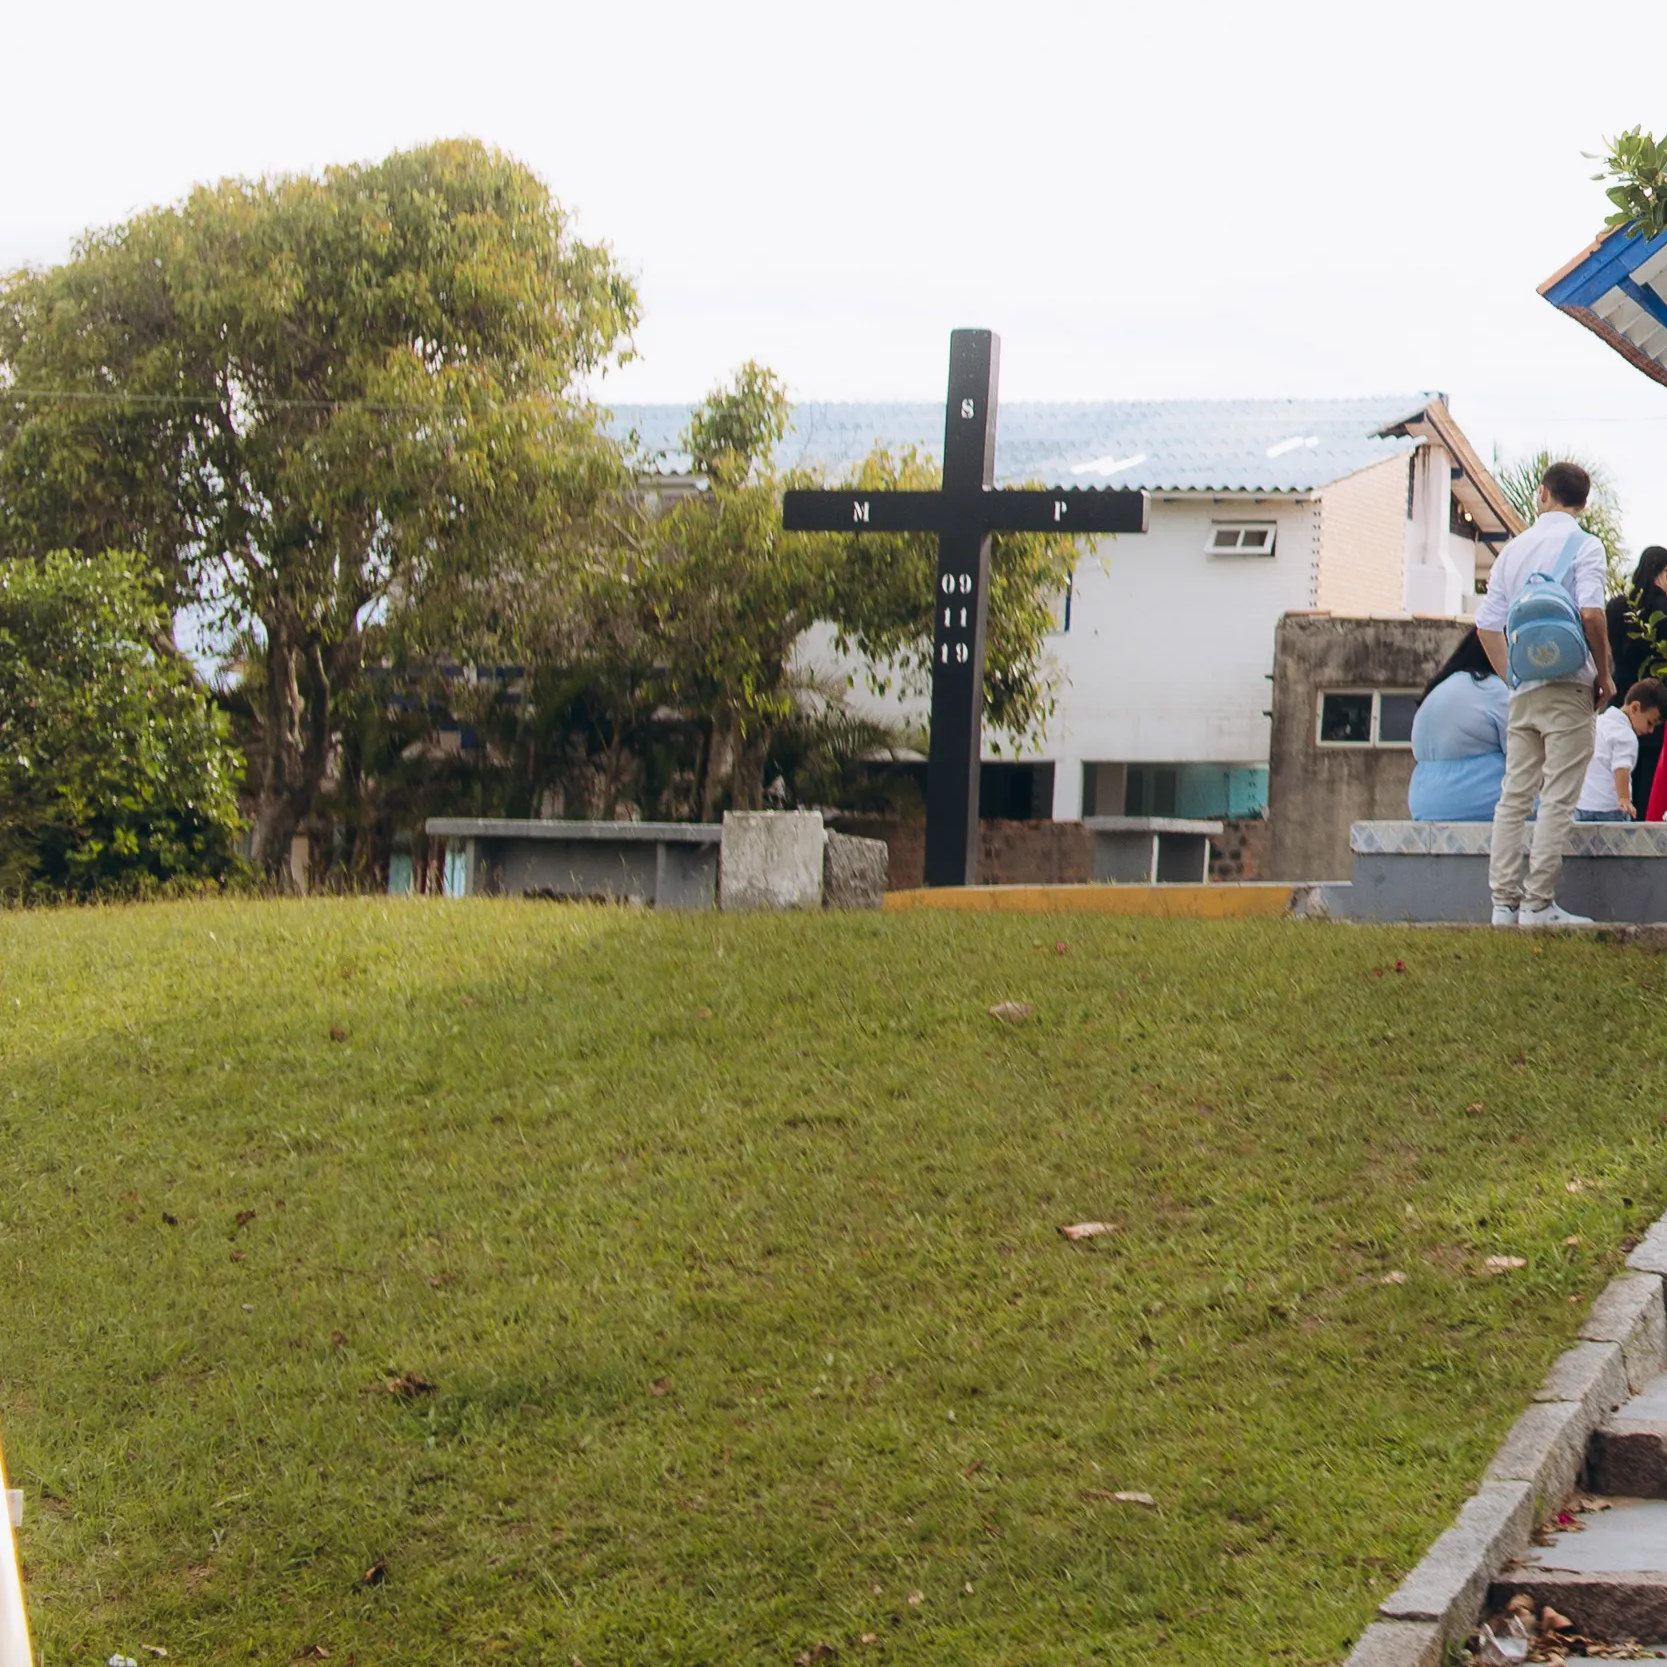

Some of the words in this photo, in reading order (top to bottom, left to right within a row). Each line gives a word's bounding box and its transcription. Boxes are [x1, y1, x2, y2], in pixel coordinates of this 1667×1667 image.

[960, 398, 974, 419] S
[853, 501, 869, 522] M
[1054, 501, 1067, 521] P
[941, 573, 972, 594] 09
[943, 607, 967, 627] 11
[941, 642, 968, 663] 19
